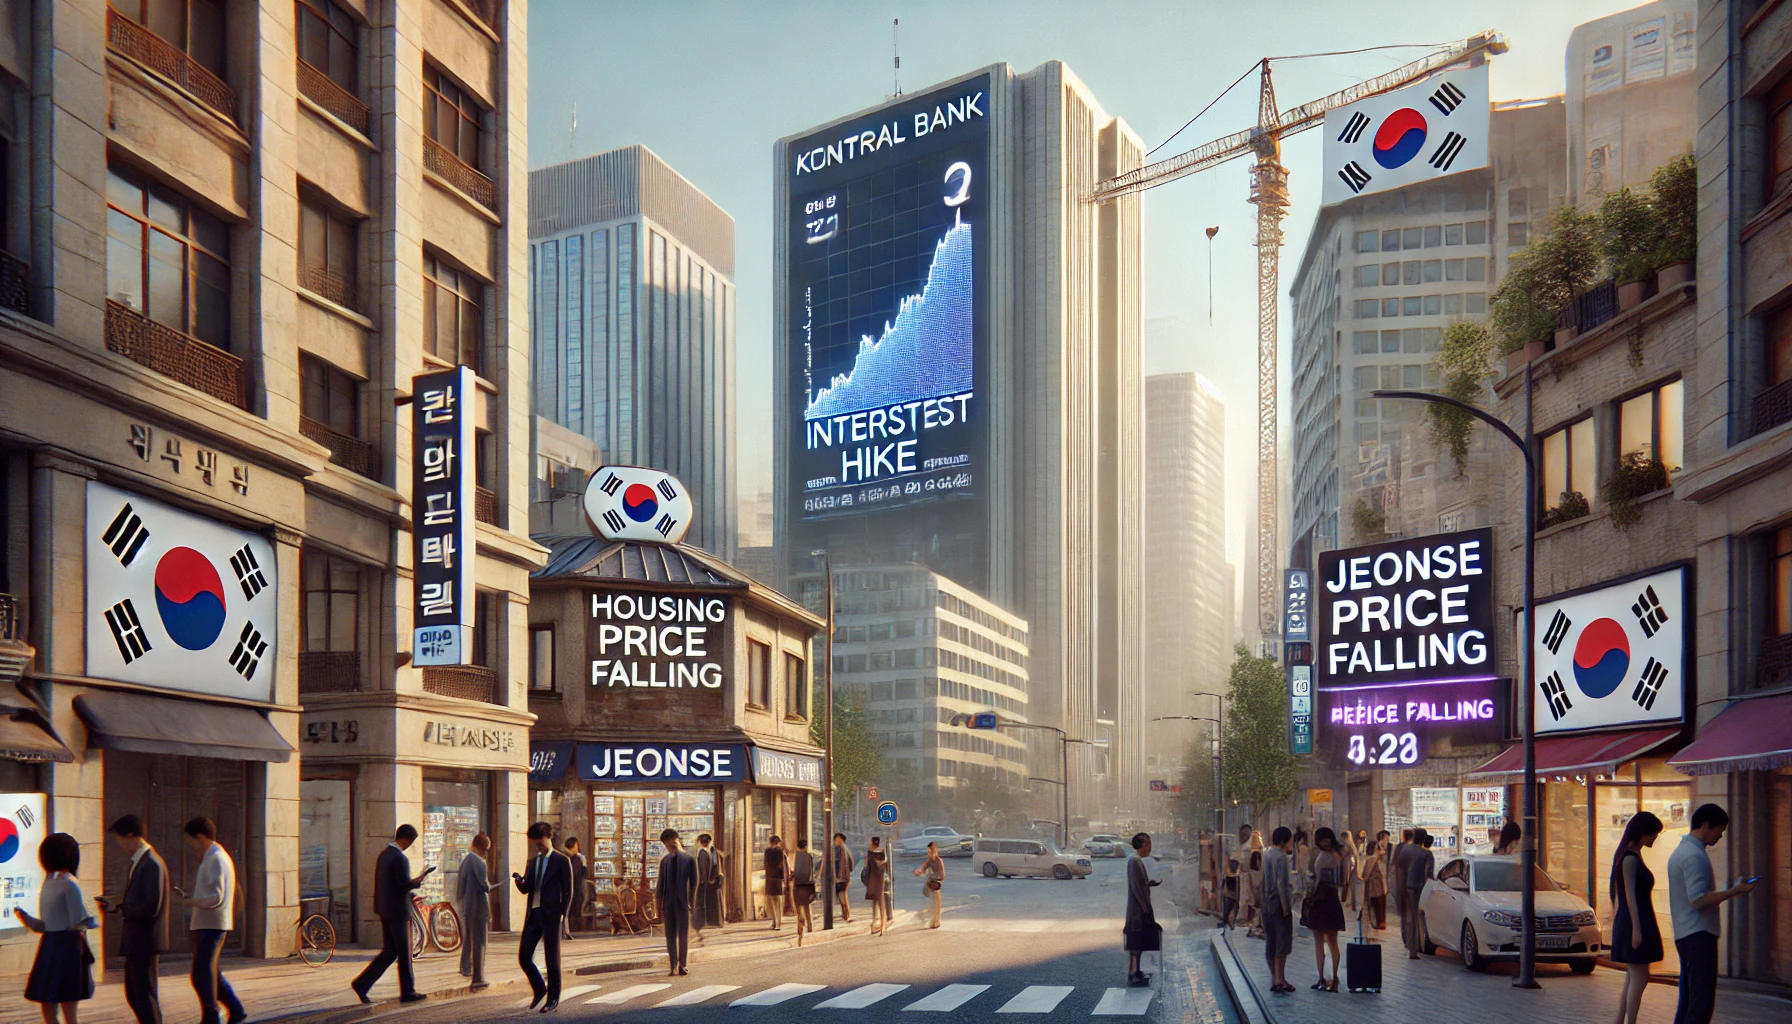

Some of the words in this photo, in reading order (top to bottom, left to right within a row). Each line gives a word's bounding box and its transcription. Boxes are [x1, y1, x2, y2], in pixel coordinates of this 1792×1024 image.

[796, 121, 906, 175] KONTRAL
[914, 92, 984, 138] BANK
[806, 393, 973, 450] INTERSTEST
[842, 439, 918, 482] HIKE
[1326, 541, 1483, 593] JEONSE
[592, 594, 725, 623] HOUSING
[1332, 584, 1470, 635] PRICE
[600, 624, 707, 657] PRICE
[1329, 630, 1487, 675] FALLING
[592, 659, 723, 688] FALLING
[1406, 699, 1494, 722] FALLING
[592, 748, 732, 777] JEONSE
